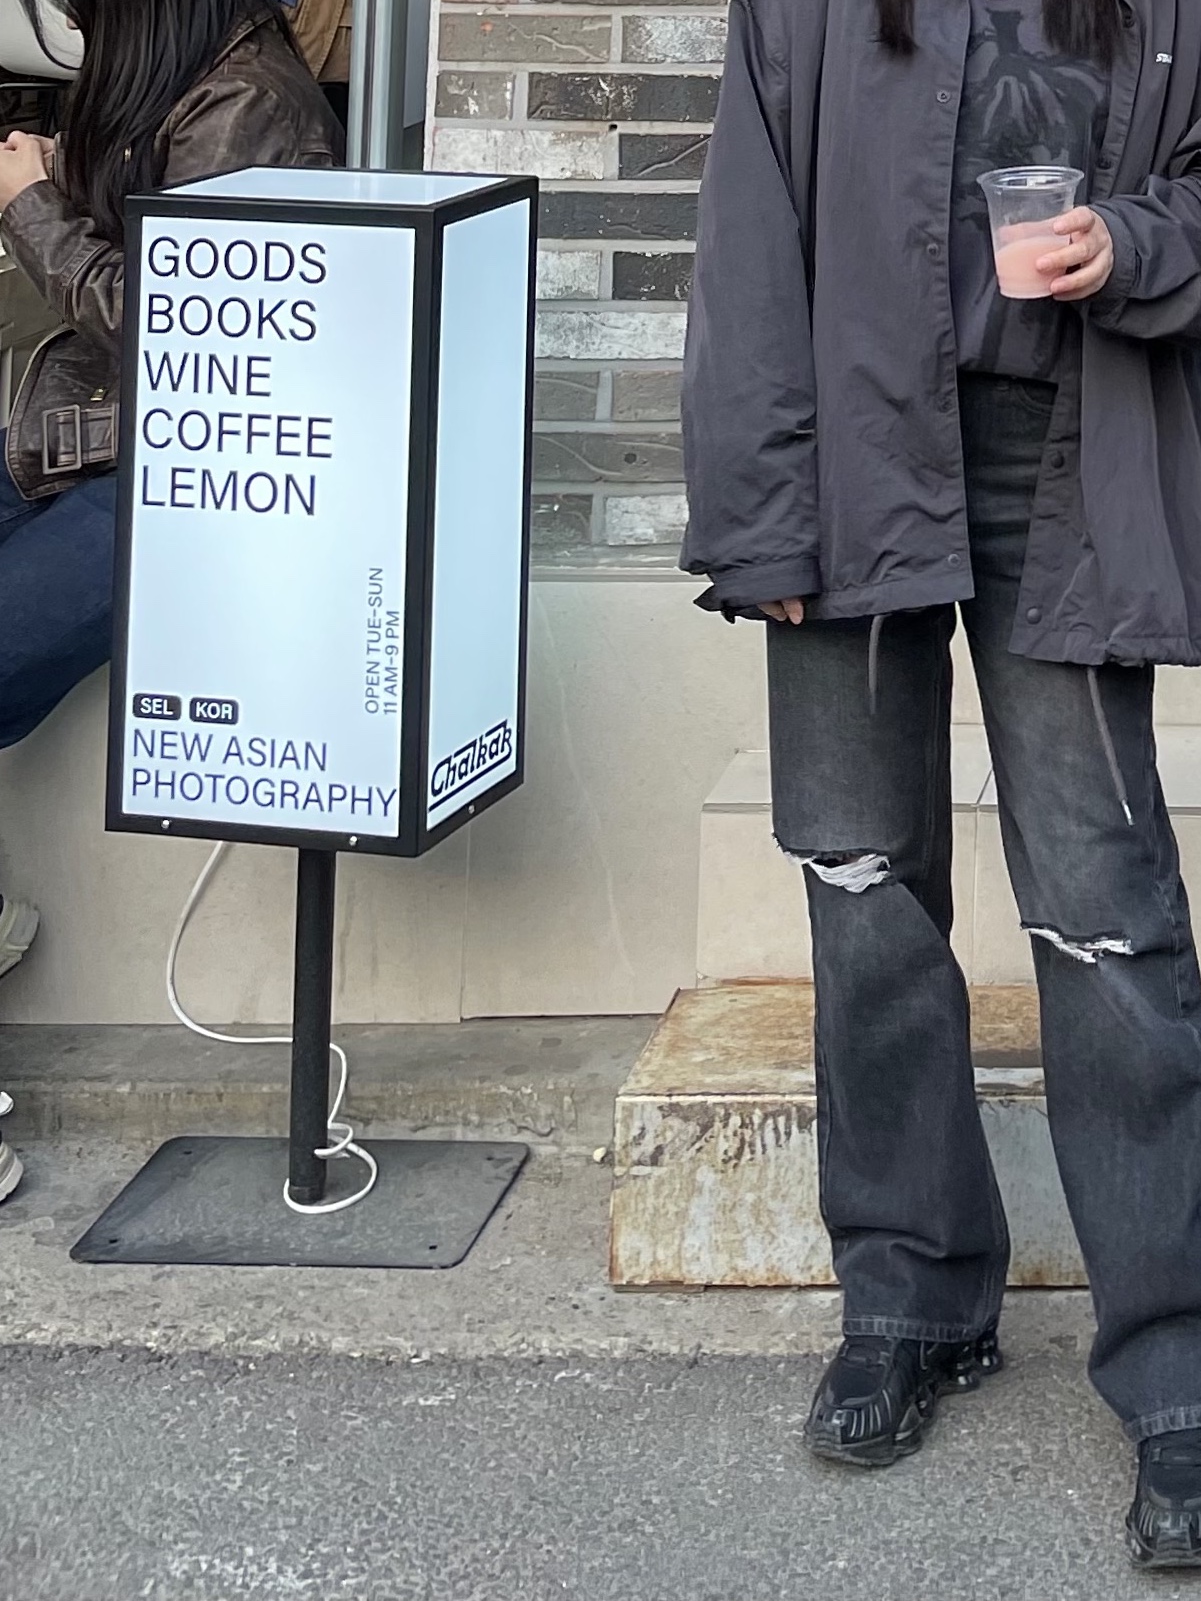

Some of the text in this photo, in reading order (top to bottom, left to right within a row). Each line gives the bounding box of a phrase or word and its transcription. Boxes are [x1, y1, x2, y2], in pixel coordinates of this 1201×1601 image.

[147, 236, 328, 285] GOODS
[146, 294, 318, 342] BOOKS
[143, 351, 272, 398] WINE
[142, 408, 333, 459] COFFEE
[141, 466, 316, 517] LEMON
[385, 611, 400, 639] PM
[140, 697, 233, 720] SEL KOR
[365, 661, 380, 714] OPEN
[133, 728, 328, 772] NEW ASIAN
[430, 719, 512, 802] Chalkak
[132, 768, 397, 817] PHOTOGRAPHY
